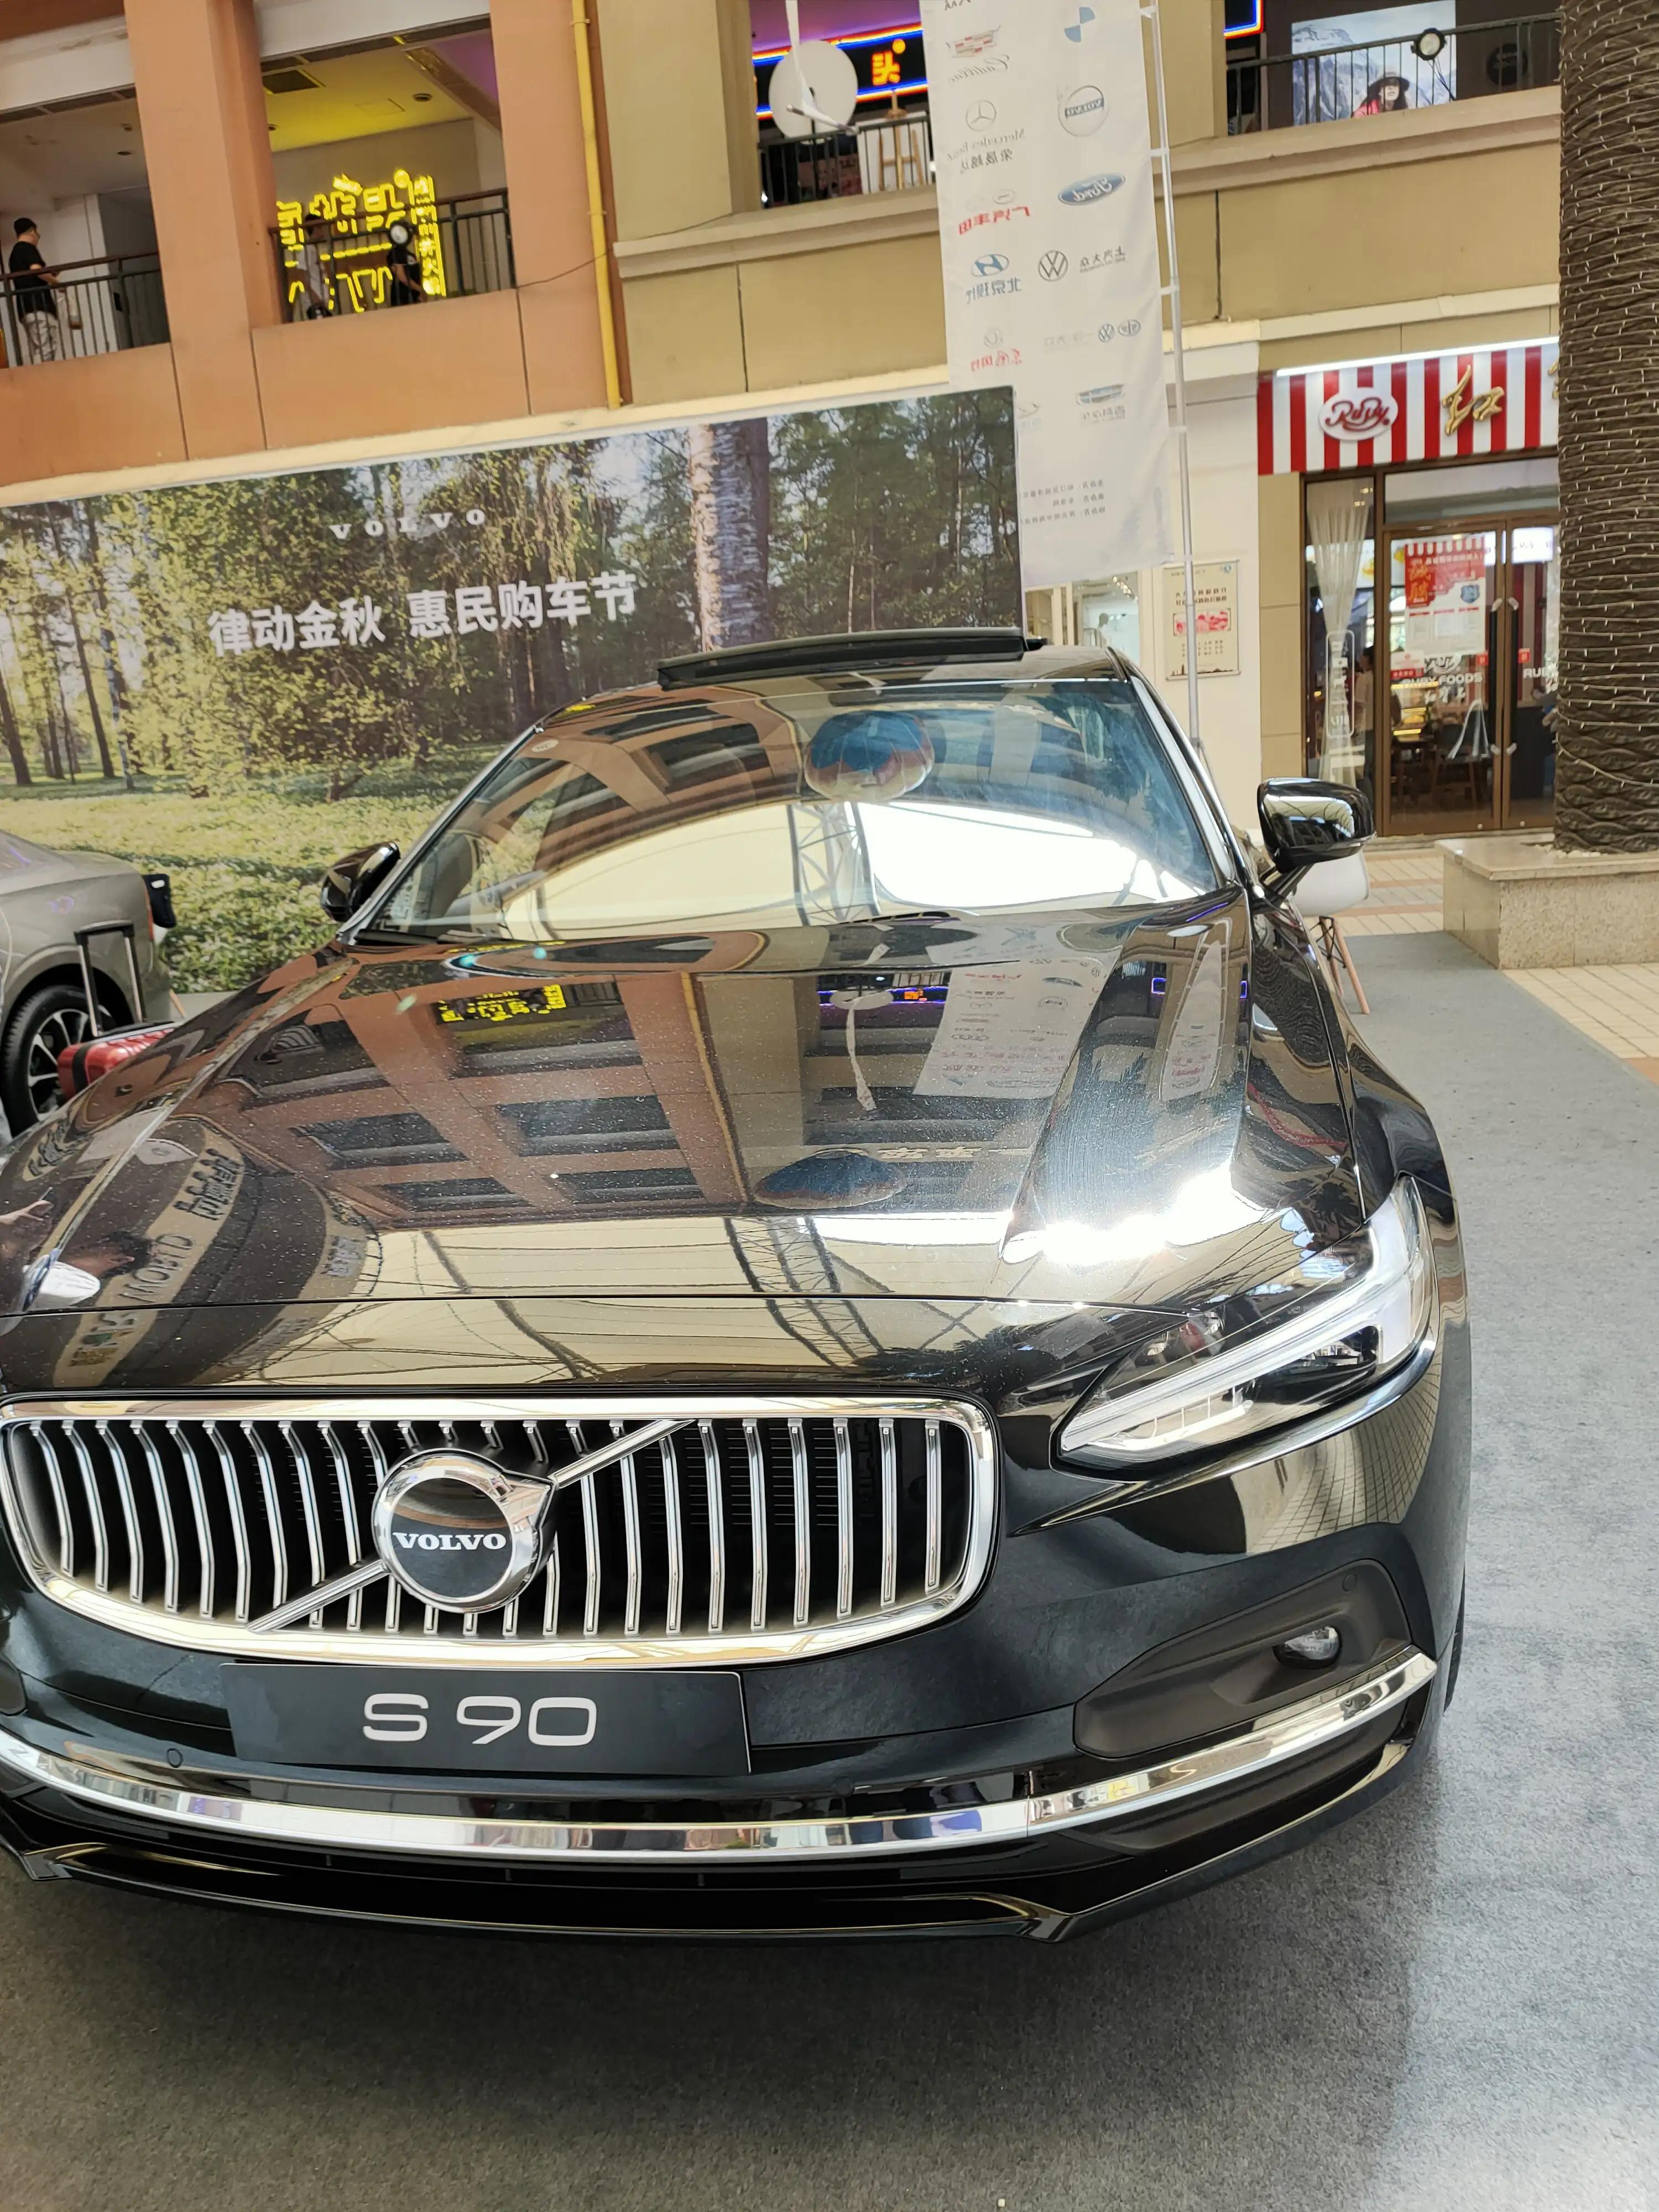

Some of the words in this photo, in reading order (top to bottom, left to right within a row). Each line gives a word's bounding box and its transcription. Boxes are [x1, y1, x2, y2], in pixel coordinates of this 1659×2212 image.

[331, 508, 486, 540] VOLVO
[207, 595, 386, 658] 律动金秋
[406, 569, 638, 640] 惠民购车节
[392, 1532, 507, 1551] VOLVO
[362, 1693, 429, 1743] S
[456, 1695, 597, 1747] 90
